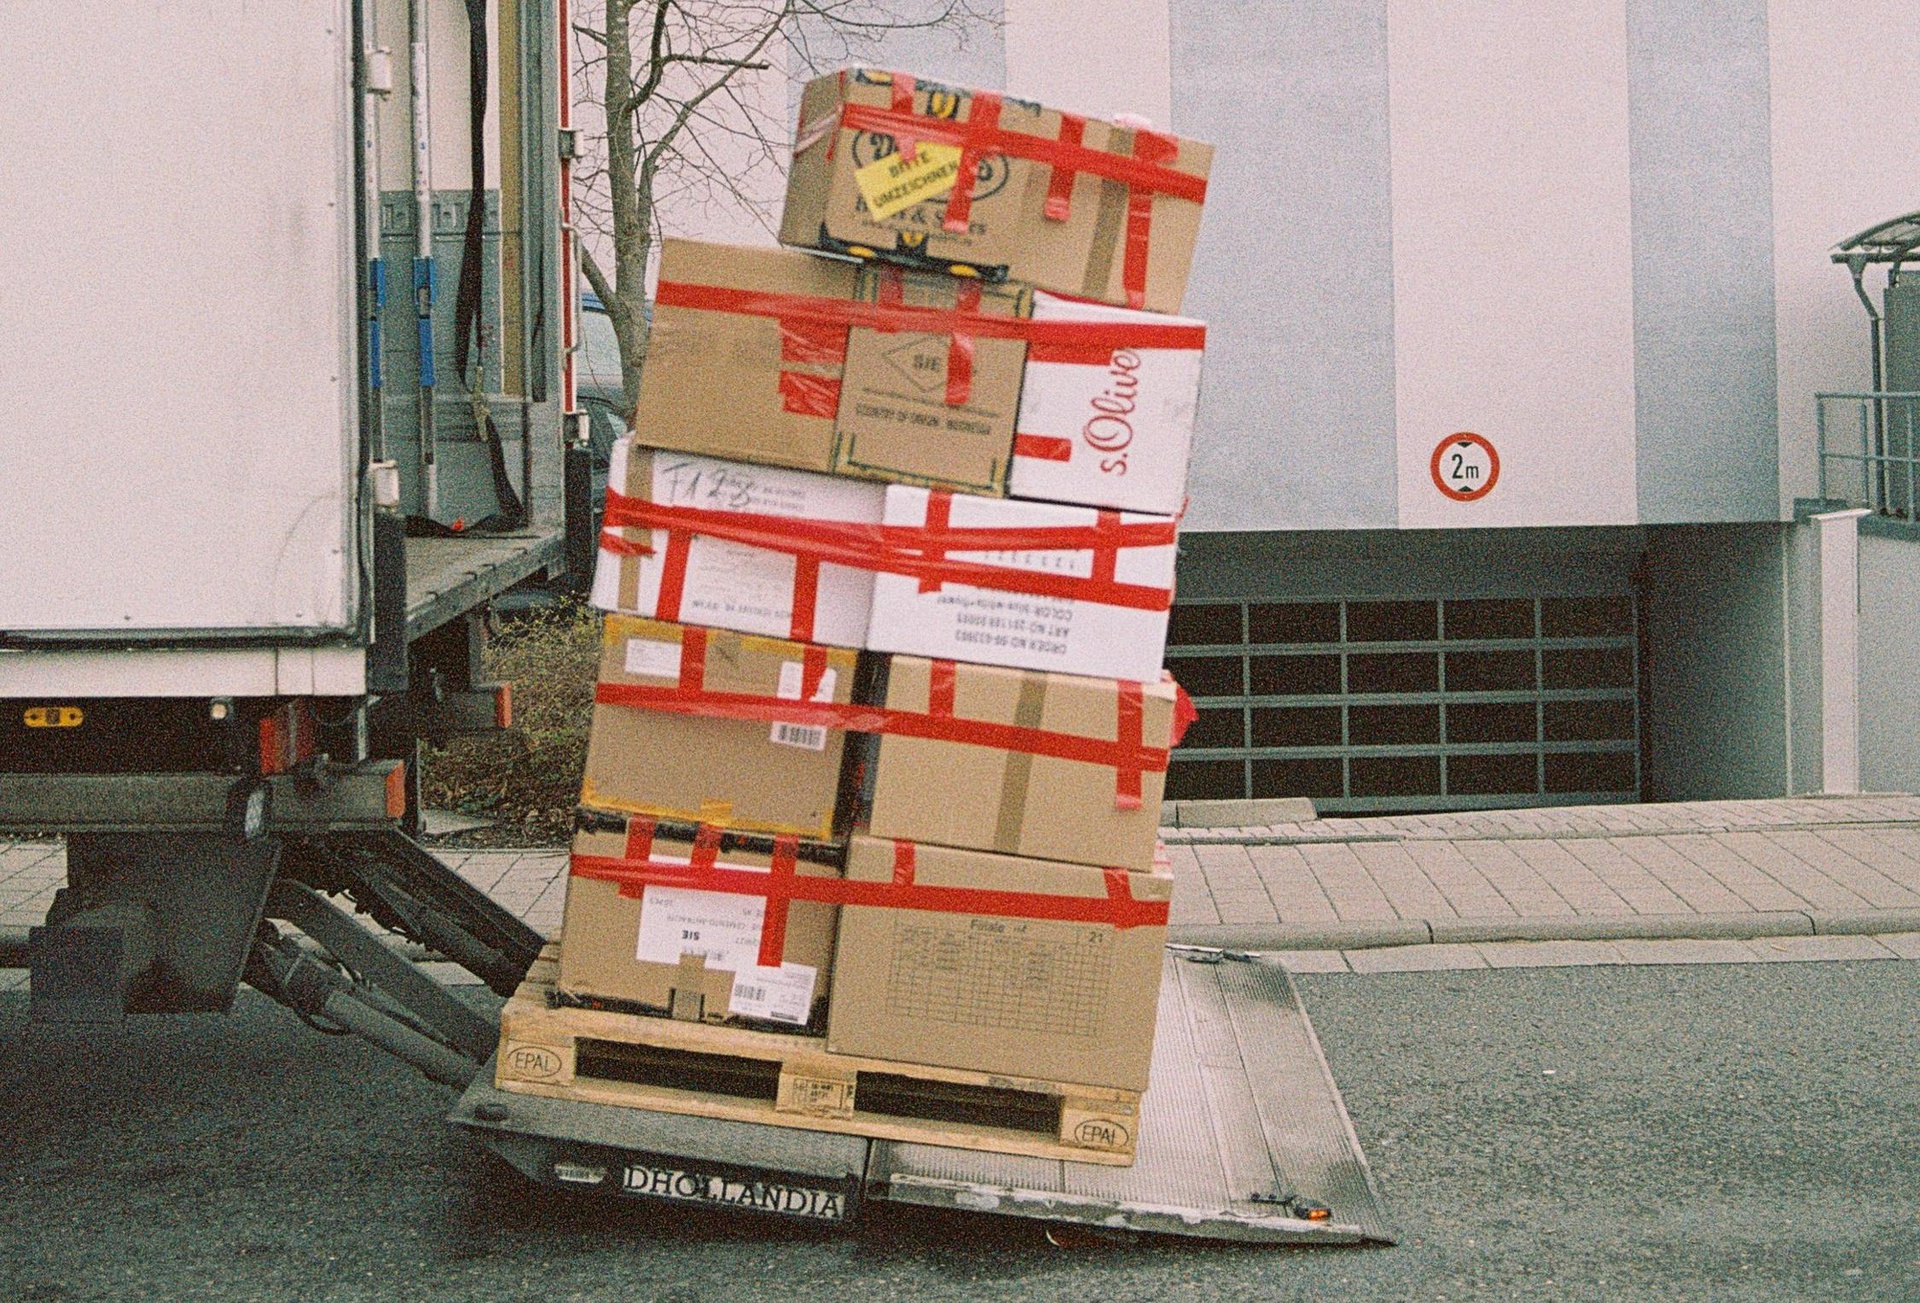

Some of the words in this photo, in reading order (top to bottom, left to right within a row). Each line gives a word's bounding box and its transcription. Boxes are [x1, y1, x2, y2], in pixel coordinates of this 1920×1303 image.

[887, 149, 930, 177] BITTE
[681, 929, 700, 940] SIE
[514, 1052, 552, 1071] EPAL
[624, 1166, 843, 1219] DHOLLANDIA
